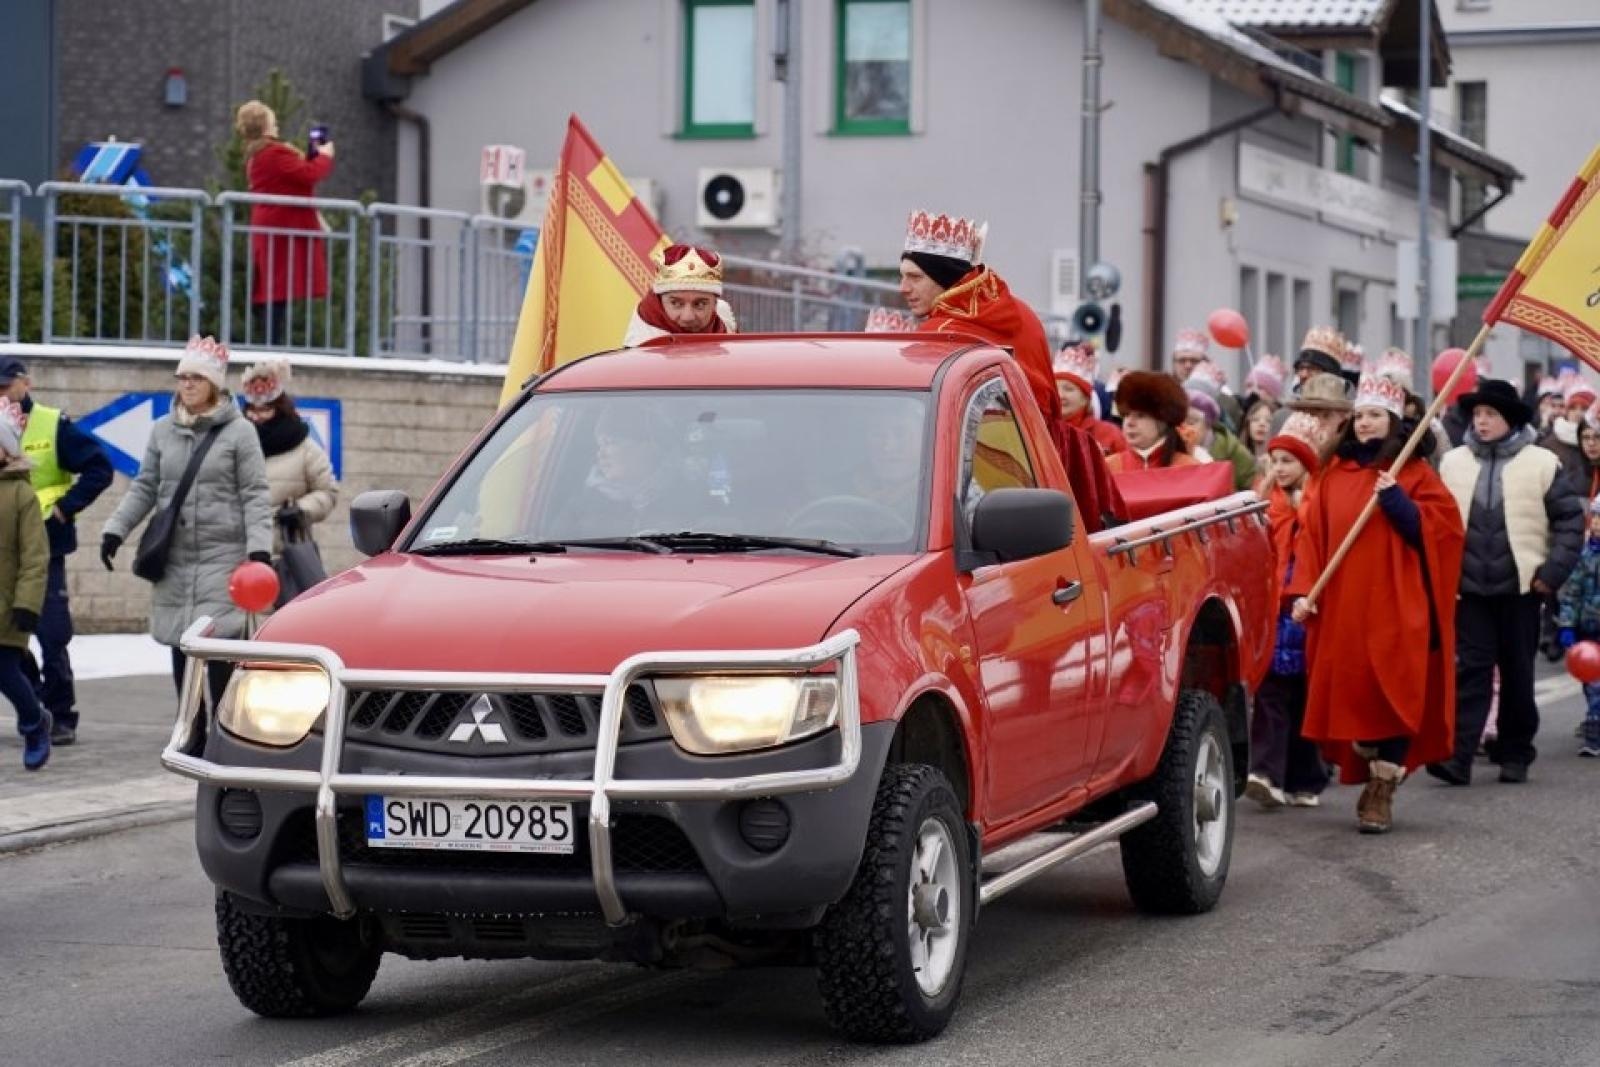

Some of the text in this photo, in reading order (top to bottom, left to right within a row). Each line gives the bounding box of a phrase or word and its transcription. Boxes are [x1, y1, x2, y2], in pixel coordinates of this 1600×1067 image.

[369, 822, 383, 832] PL
[386, 801, 569, 841] SWD 20985
